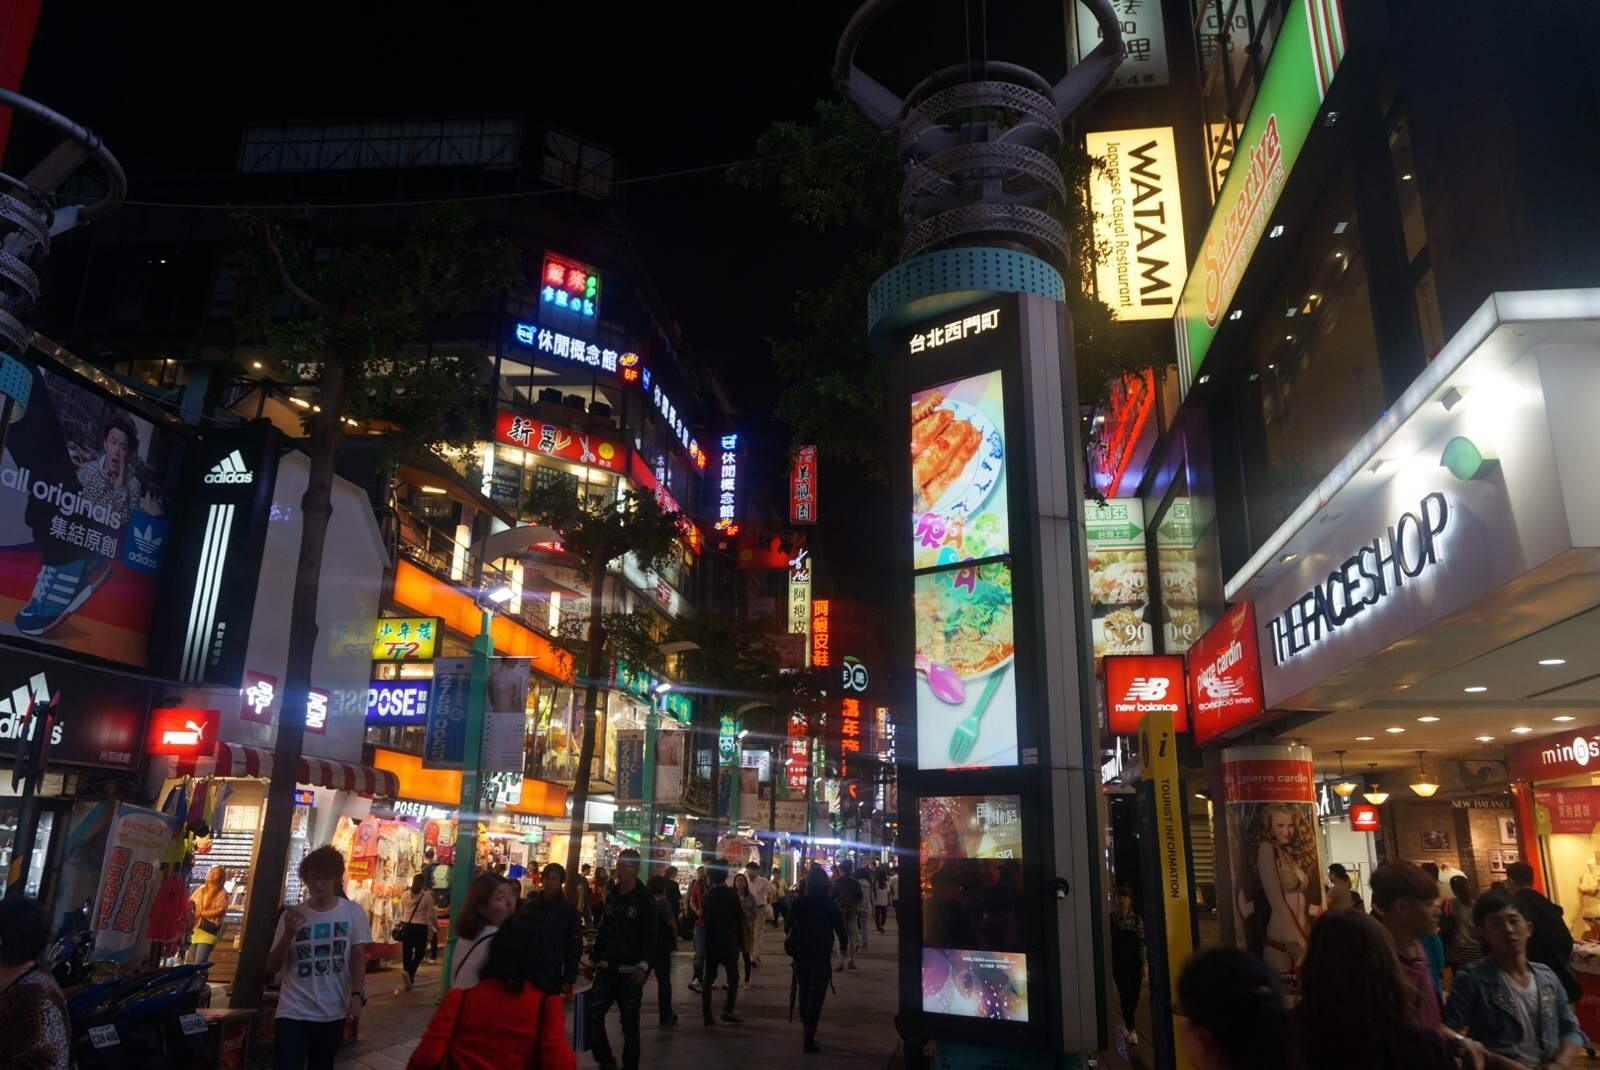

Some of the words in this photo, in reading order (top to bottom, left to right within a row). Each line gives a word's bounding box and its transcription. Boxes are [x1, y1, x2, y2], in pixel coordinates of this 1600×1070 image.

[1107, 142, 1122, 196] Japanese
[1114, 197, 1127, 240] Casual
[1128, 140, 1174, 306] WATAMI
[1205, 113, 1281, 328] Saizeriya
[1119, 241, 1134, 308] Restaurant
[909, 308, 1000, 355] 台北西門町
[1, 466, 30, 495] all
[32, 477, 122, 531] originals
[204, 470, 252, 484] adidas
[50, 516, 118, 560] 集結原創
[128, 551, 158, 568] adidas
[1216, 640, 1243, 675] cardin
[365, 687, 418, 716] POSE
[1115, 704, 1136, 712] new
[1137, 703, 1179, 712] balance
[1160, 778, 1173, 823] TOURIST
[1242, 774, 1274, 785] pierre
[1277, 773, 1308, 784] cardin
[394, 801, 420, 816] POSE
[1452, 800, 1471, 808] NEW
[1166, 824, 1180, 899] INFORMATION
